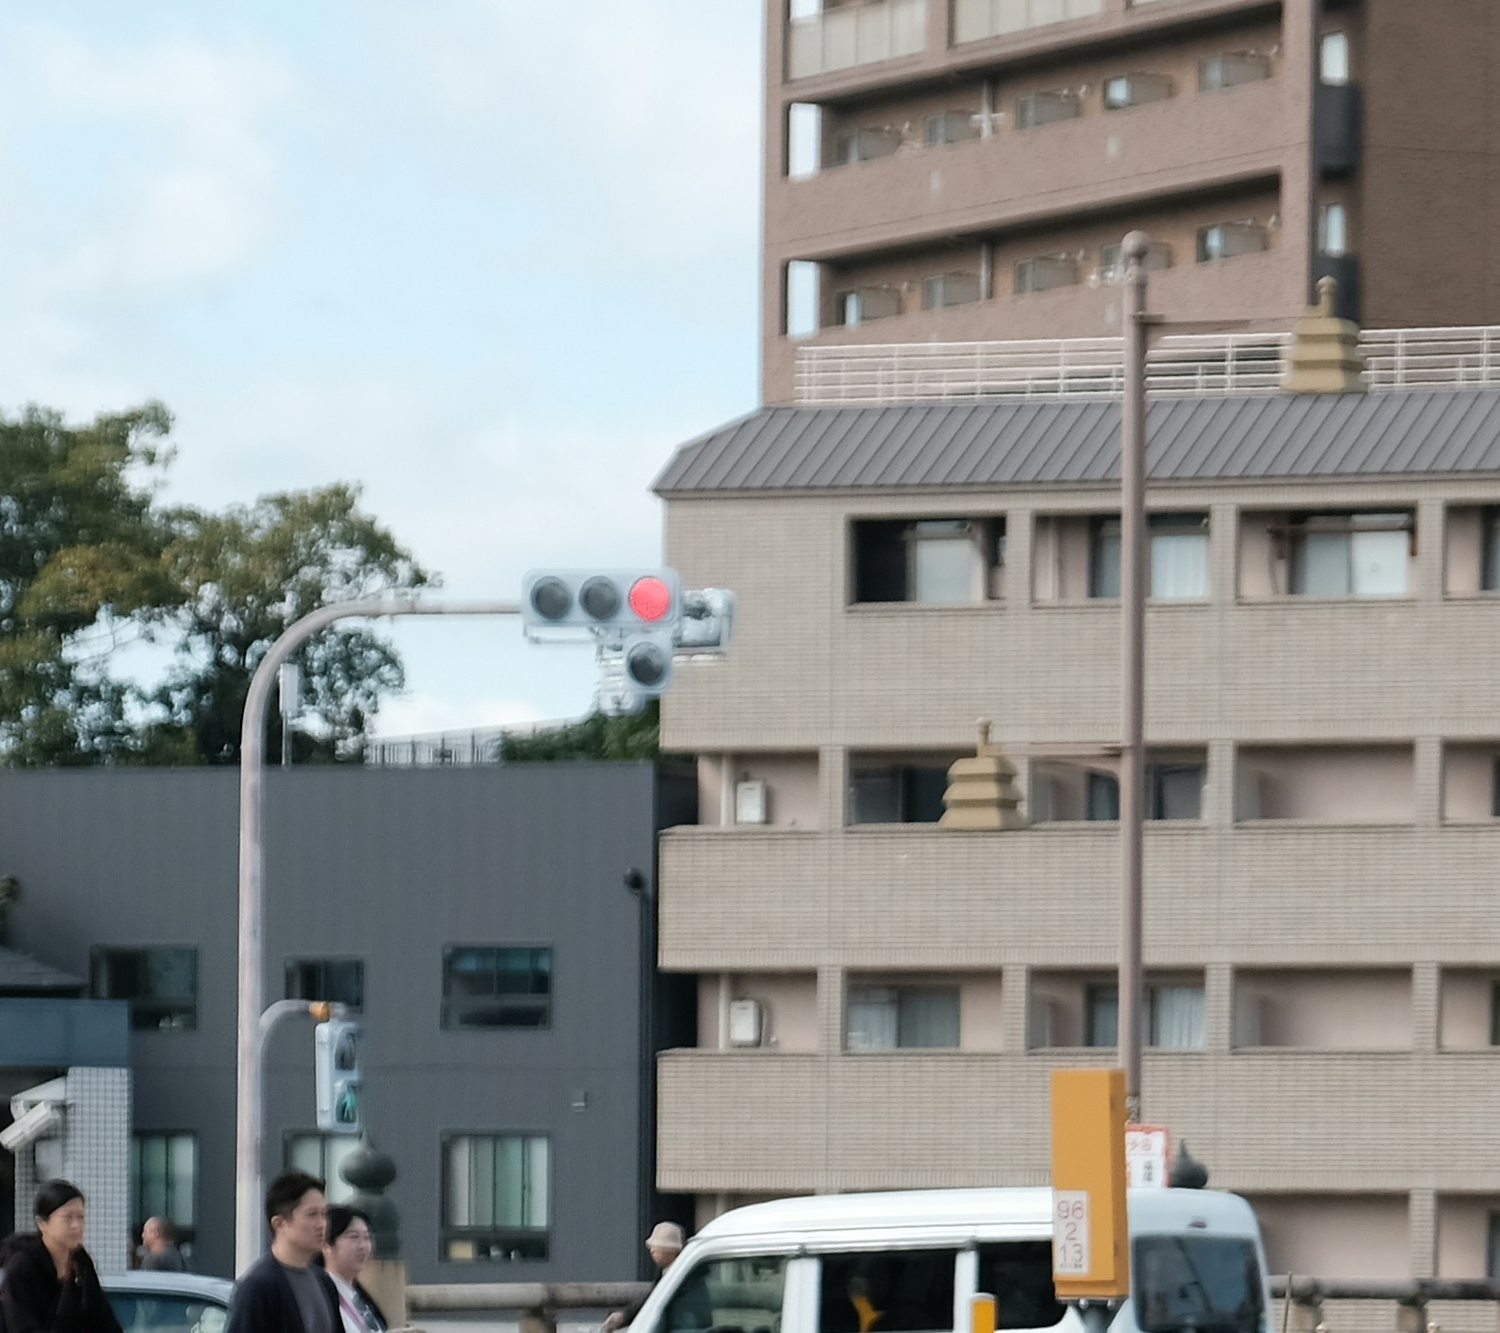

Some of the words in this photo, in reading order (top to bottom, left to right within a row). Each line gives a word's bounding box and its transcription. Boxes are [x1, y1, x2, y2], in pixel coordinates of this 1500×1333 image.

[1057, 1200, 1085, 1220] 96
[1065, 1222, 1077, 1241] 2
[1059, 1244, 1084, 1262] 13
